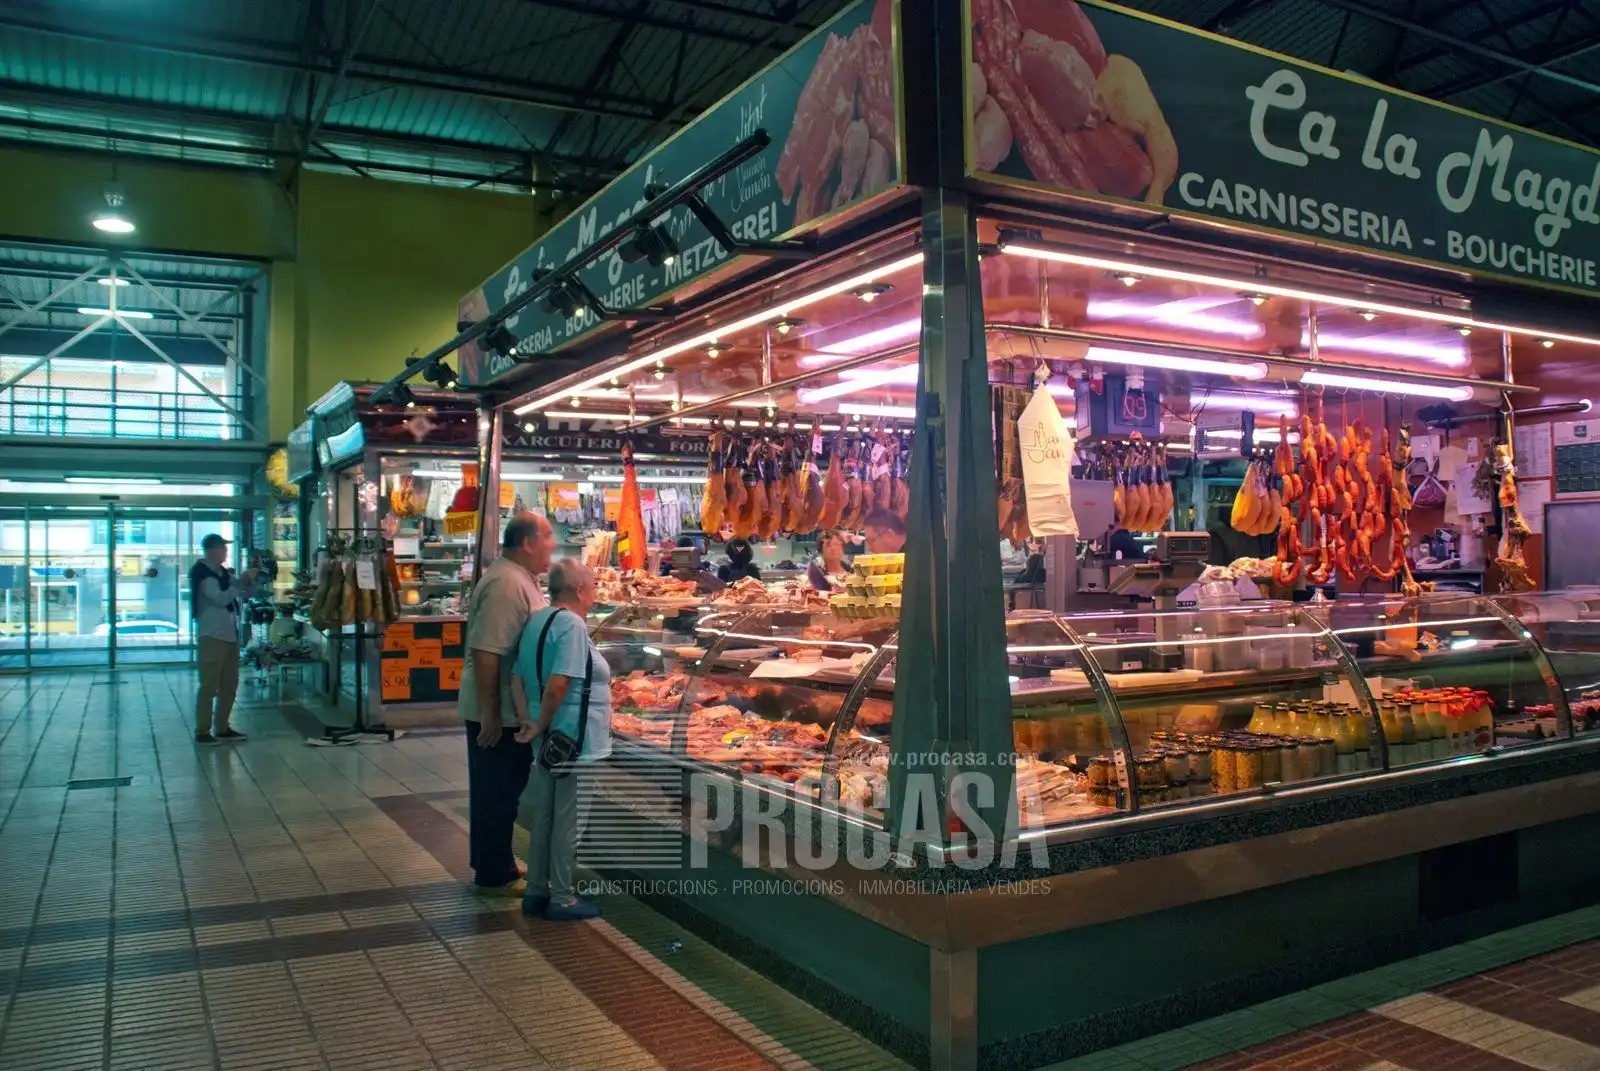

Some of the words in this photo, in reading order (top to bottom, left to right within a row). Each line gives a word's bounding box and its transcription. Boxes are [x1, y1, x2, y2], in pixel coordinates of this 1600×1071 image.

[1245, 69, 1341, 166] Ca
[1361, 98, 1421, 179] la
[1178, 172, 1413, 249] CARNISSERIA
[1447, 230, 1597, 287] BOUCHERIE
